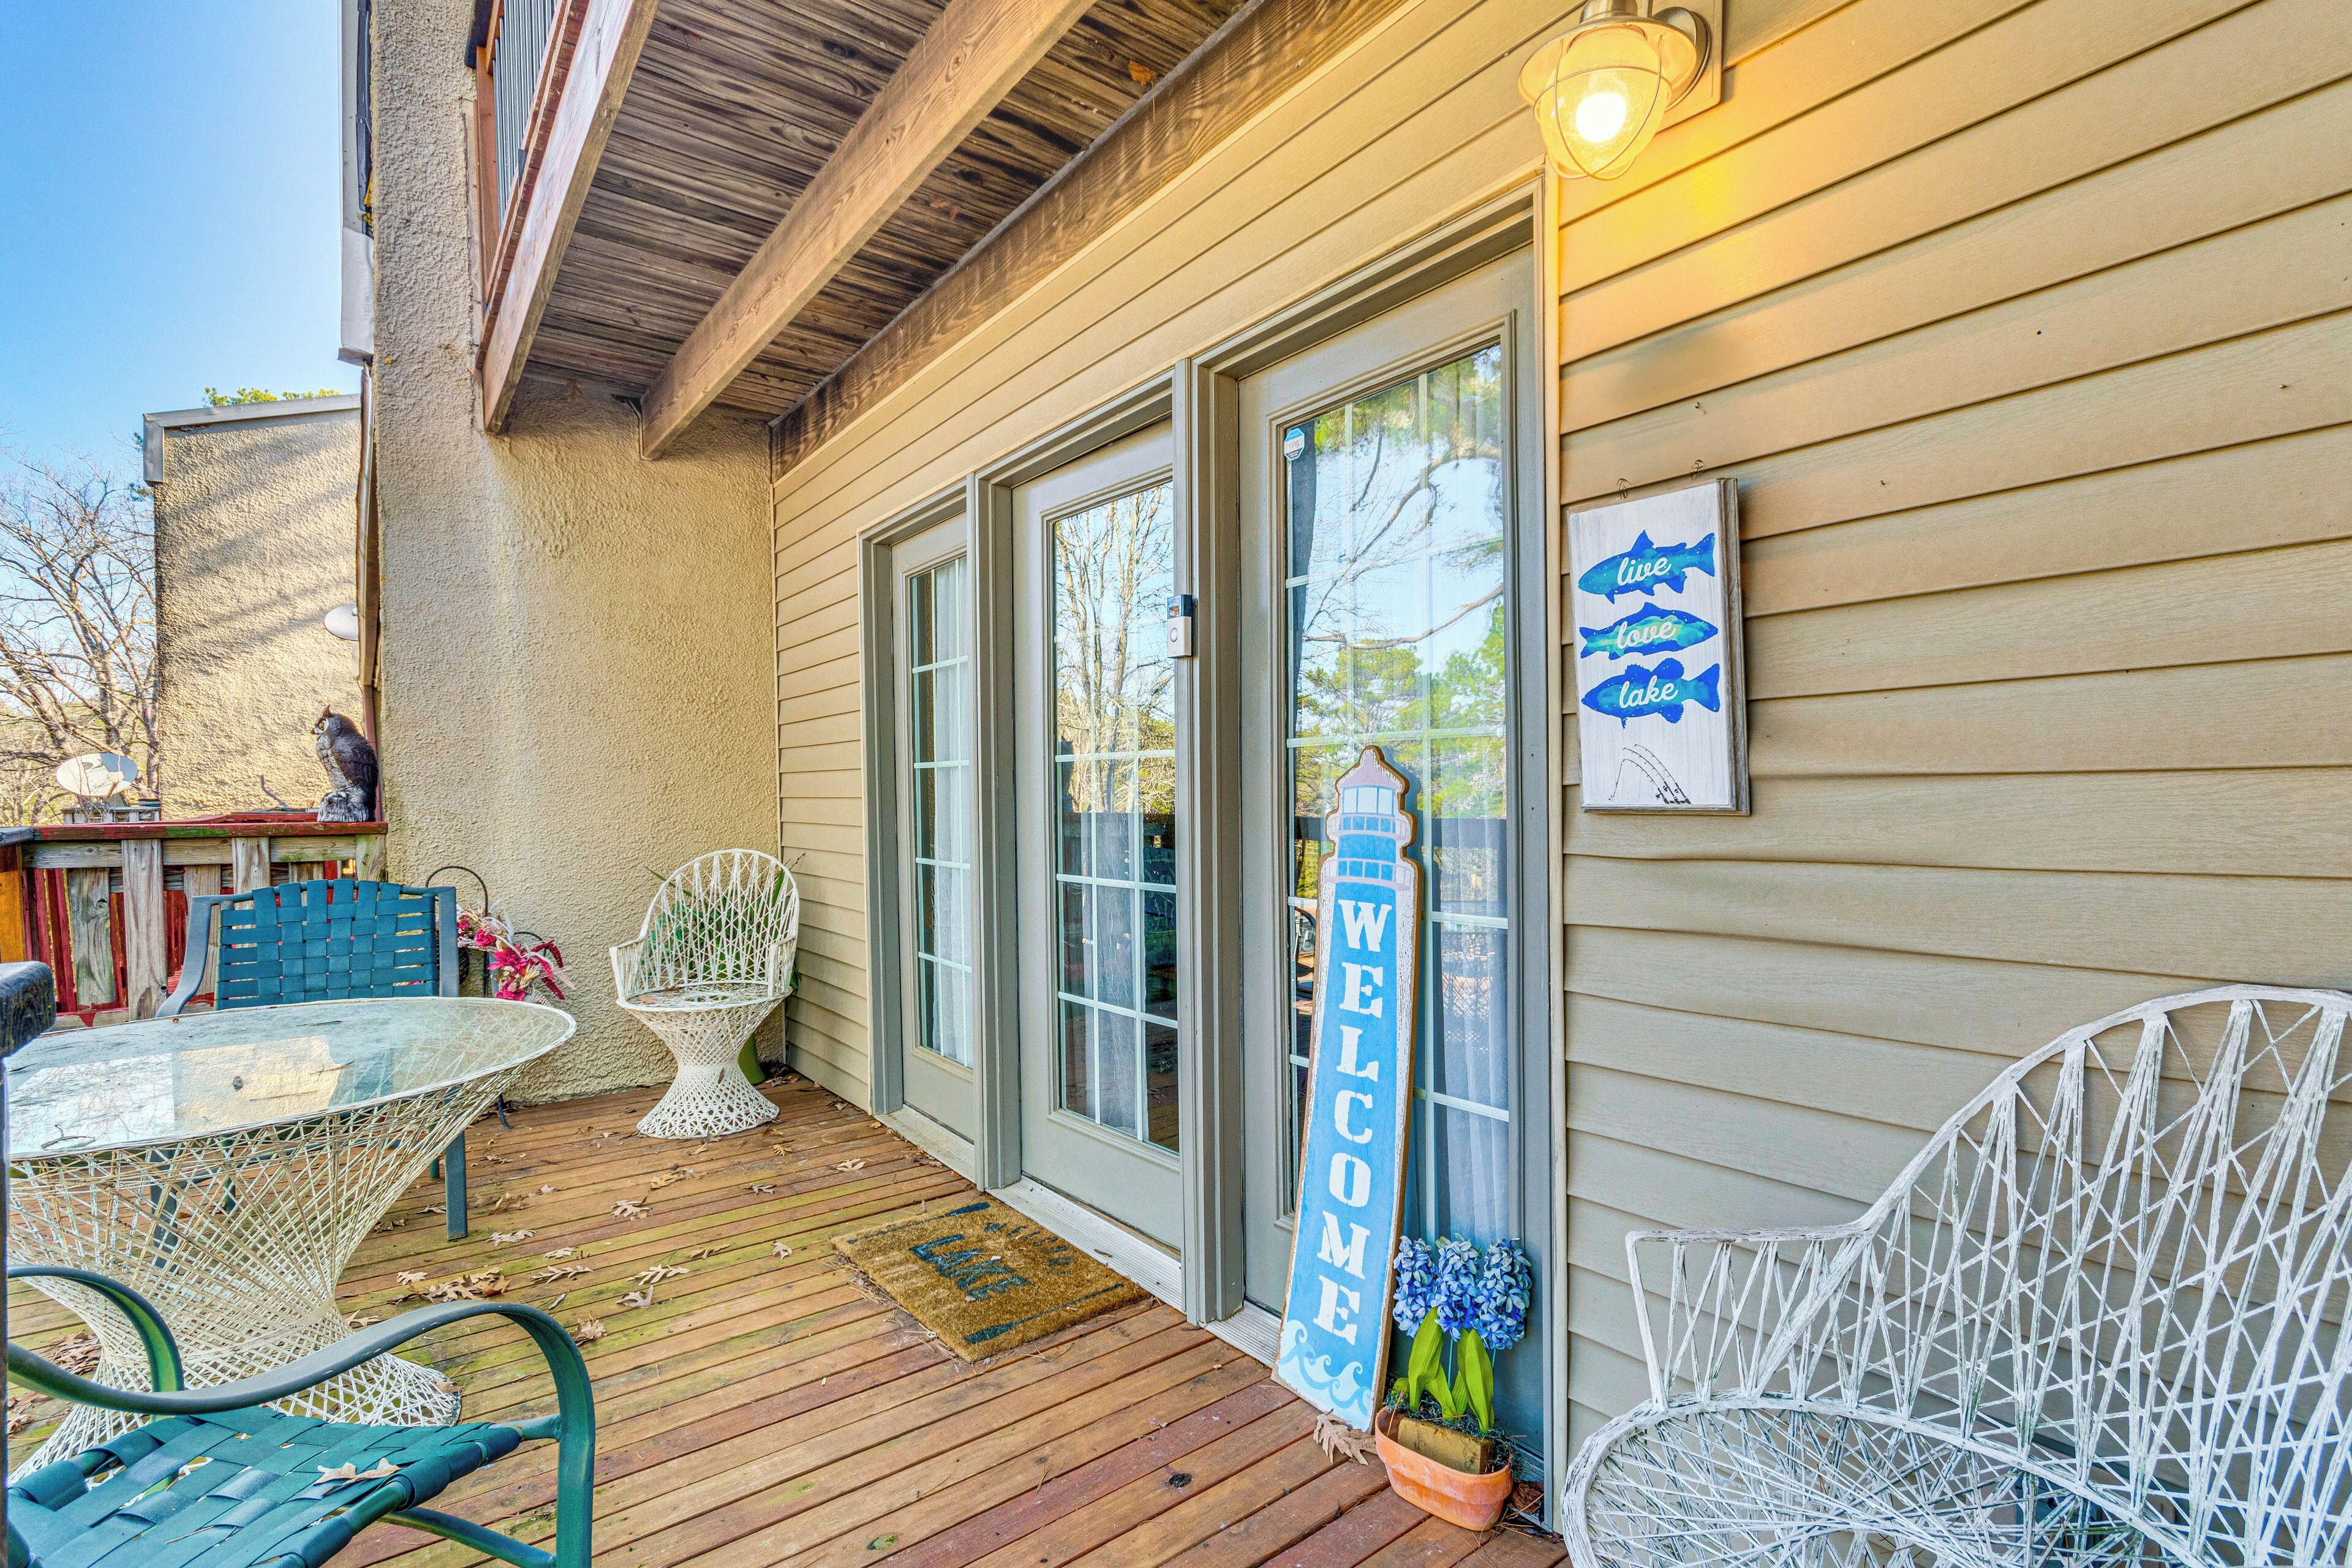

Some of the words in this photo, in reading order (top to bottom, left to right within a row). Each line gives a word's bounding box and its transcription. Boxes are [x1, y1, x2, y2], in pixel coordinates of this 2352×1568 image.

[1289, 440, 1300, 449] ring
[1617, 557, 1672, 586] live
[1617, 621, 1676, 650] love
[1619, 675, 1679, 709] lake
[1313, 899, 1392, 1346] WELCOME
[908, 1233, 1031, 1302] LAKE
